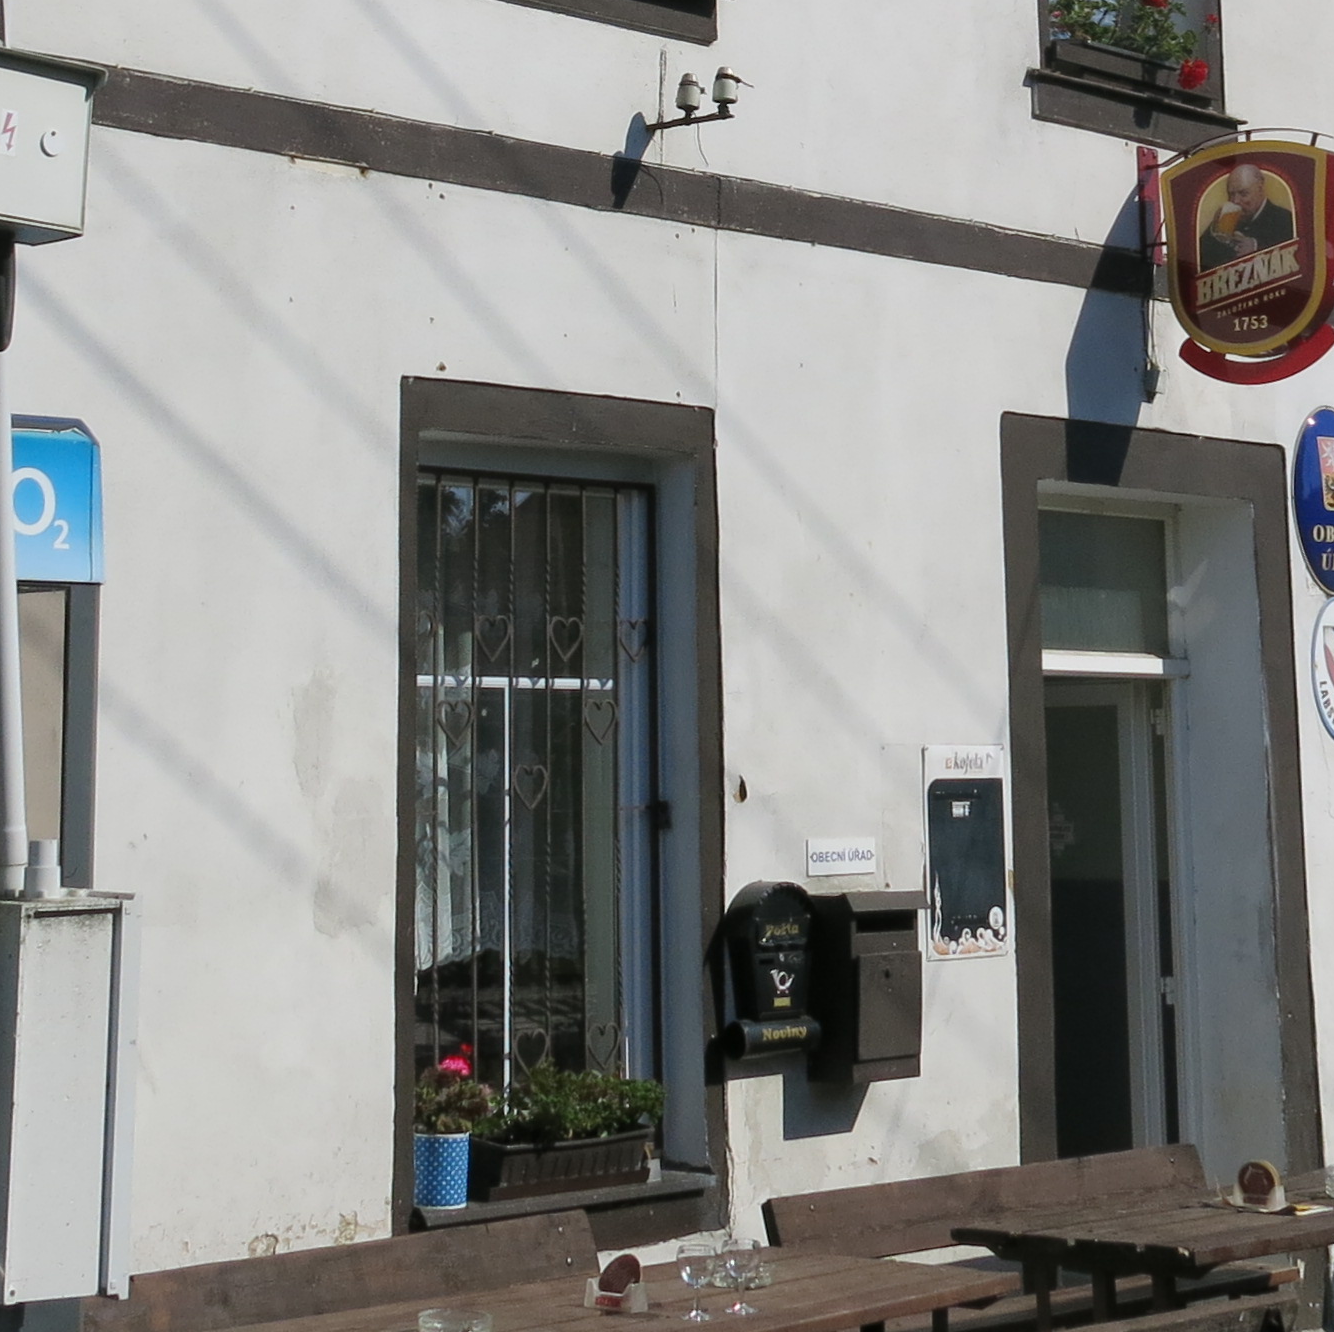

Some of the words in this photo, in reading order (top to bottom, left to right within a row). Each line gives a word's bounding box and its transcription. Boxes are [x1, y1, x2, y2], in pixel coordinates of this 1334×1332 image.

[1233, 315, 1269, 332] 1753
[811, 848, 846, 863] OBECNÍ
[848, 847, 873, 862] ÚŘAD
[762, 1024, 807, 1041] Noviny
